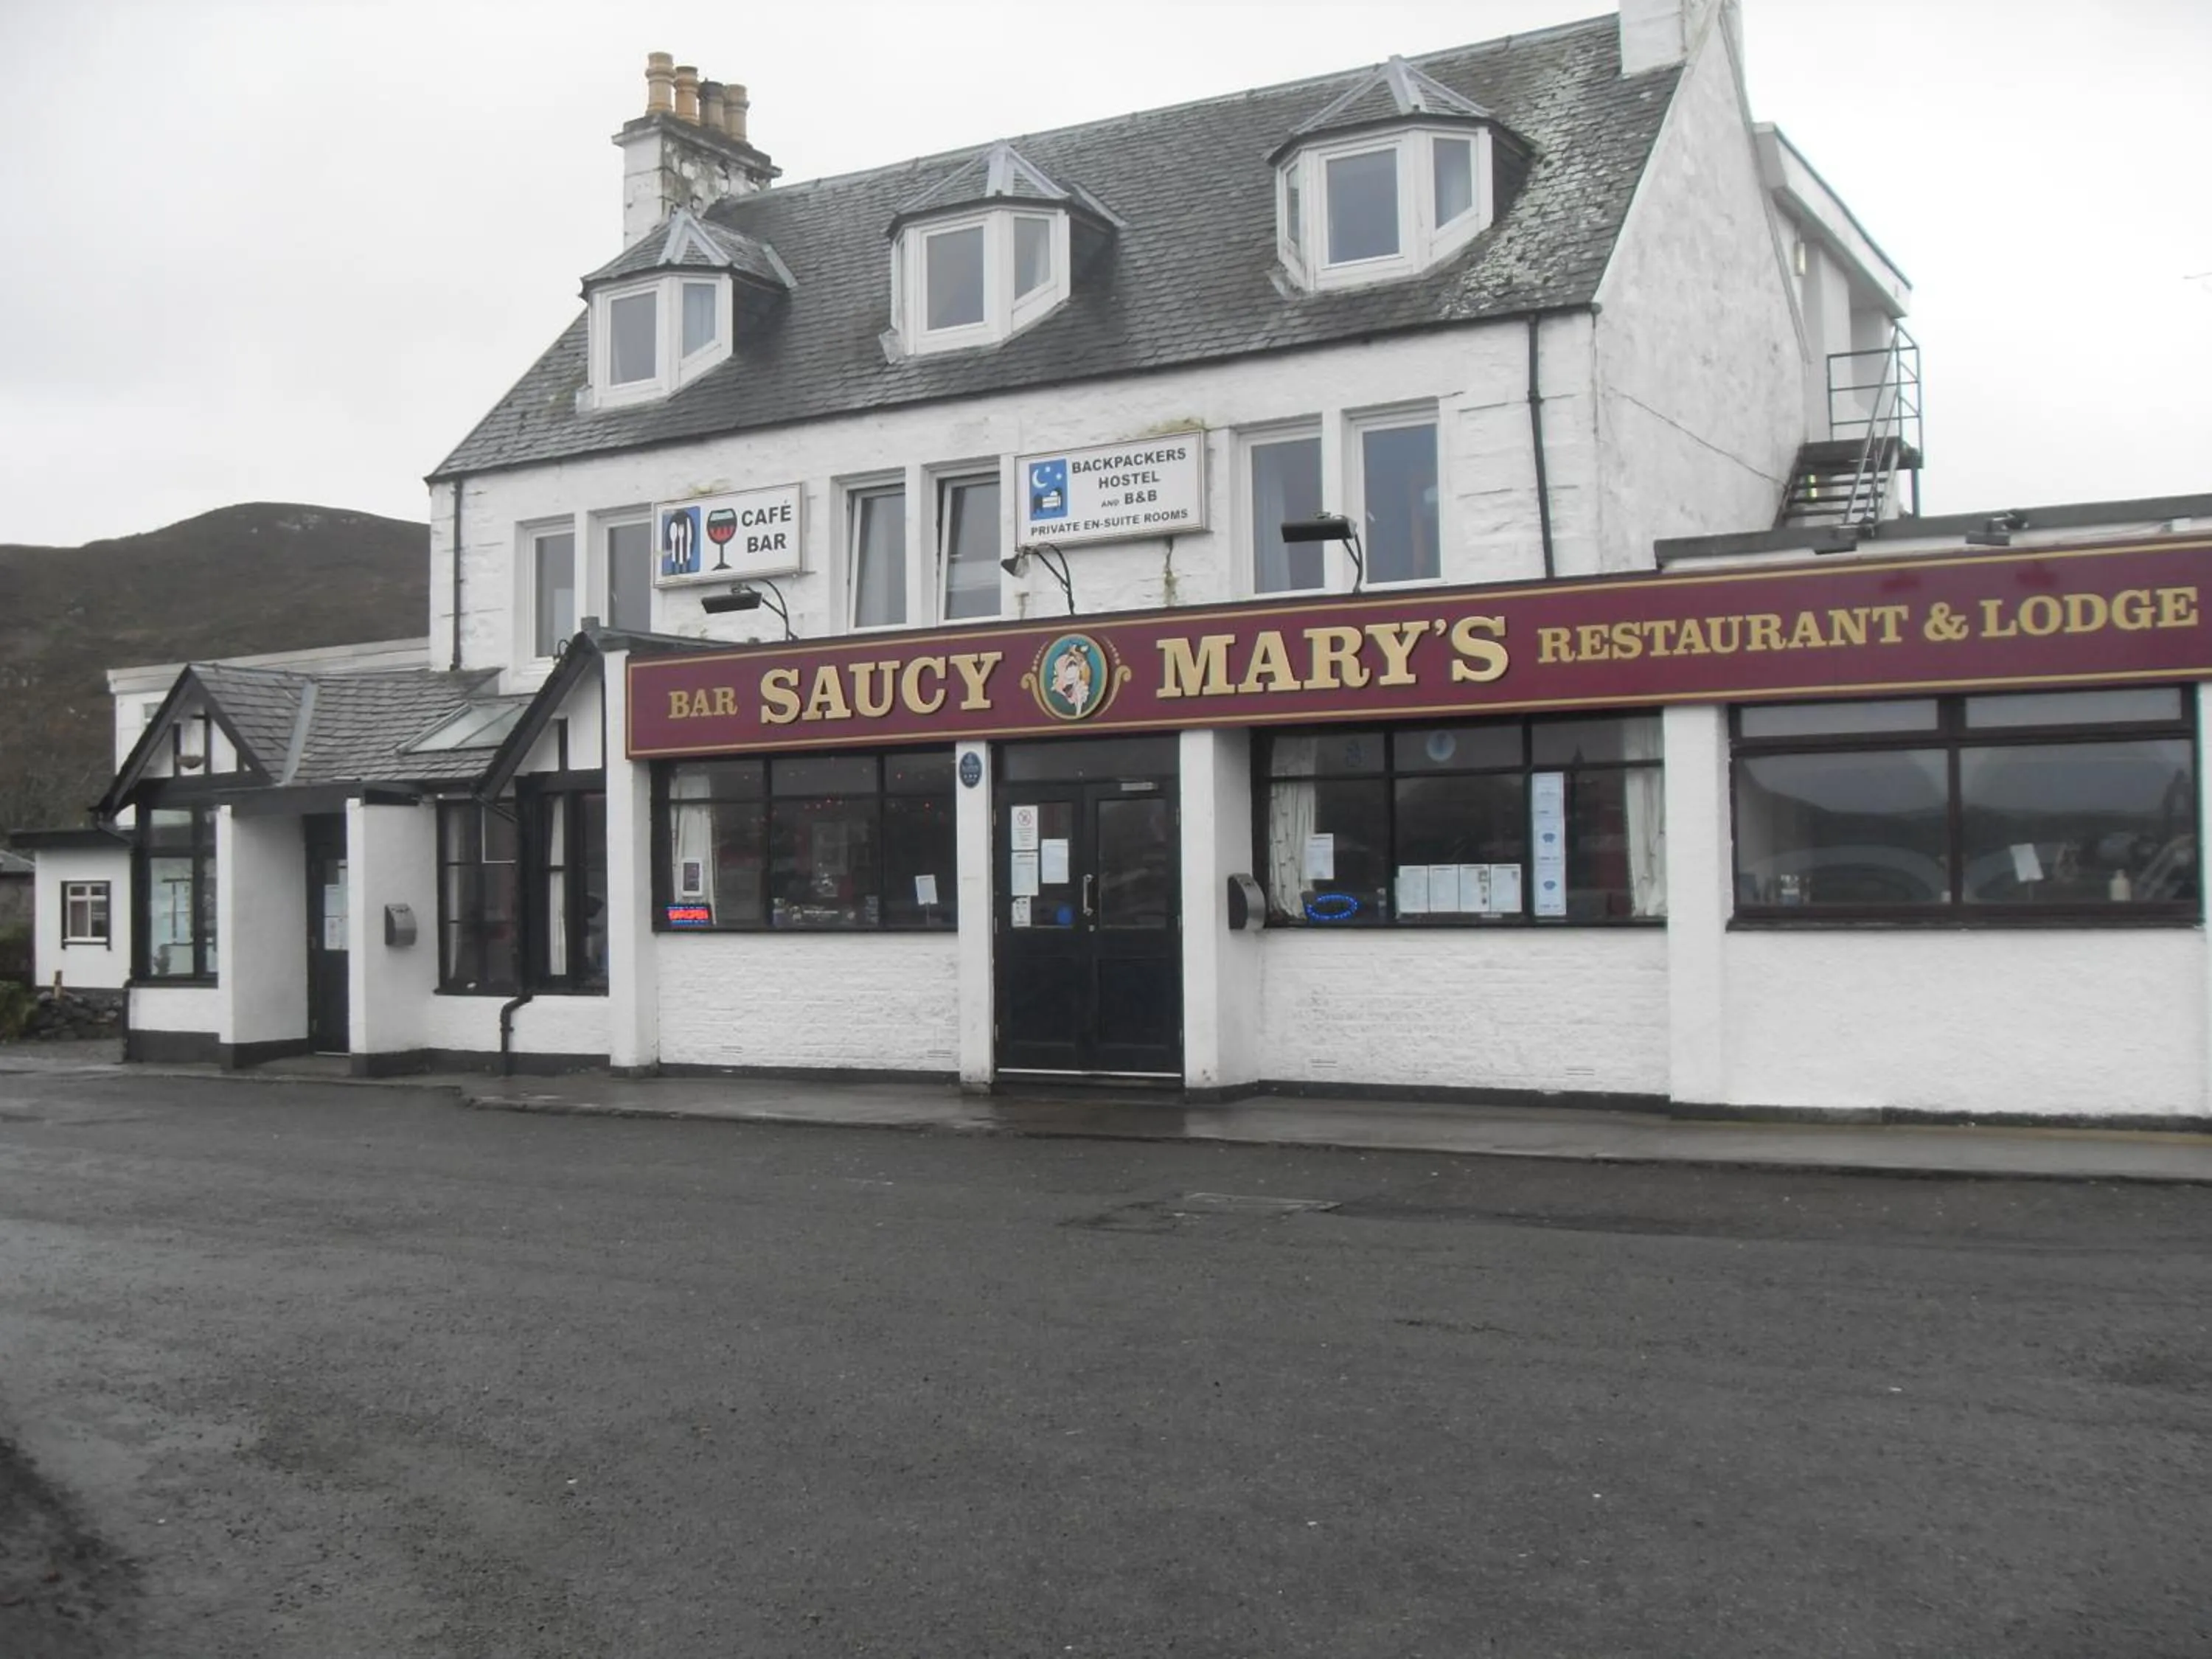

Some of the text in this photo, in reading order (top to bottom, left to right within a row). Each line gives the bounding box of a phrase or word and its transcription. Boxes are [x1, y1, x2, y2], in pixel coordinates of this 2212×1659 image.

[1072, 448, 1186, 473] BACKPACKERS
[1099, 471, 1160, 488] HOSTEL
[1102, 490, 1158, 508] AND B&B
[741, 499, 791, 527] CAFÉ
[1031, 509, 1189, 536] PRIVATE EN-SUITE ROOMS
[747, 532, 787, 554] BAR
[669, 586, 2199, 725] BAR SAUCY MARY'S RESTAURANT & LODGE
